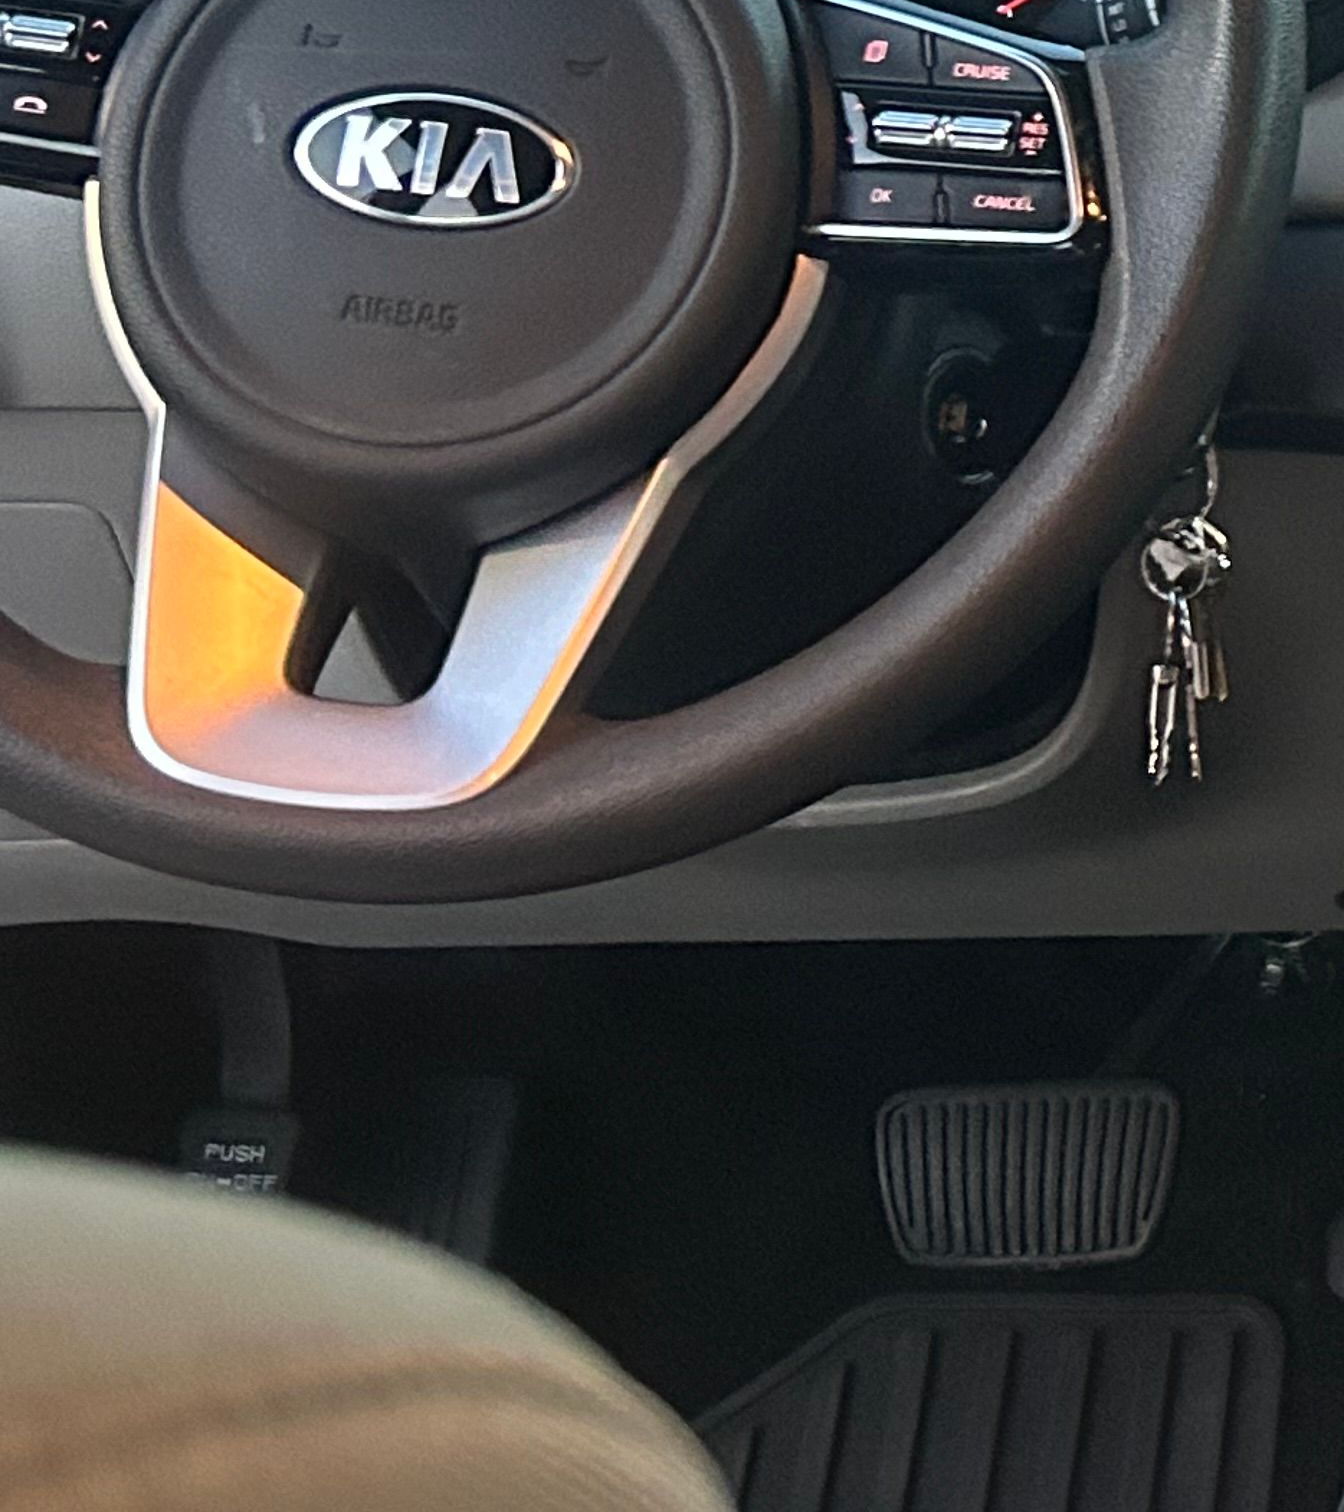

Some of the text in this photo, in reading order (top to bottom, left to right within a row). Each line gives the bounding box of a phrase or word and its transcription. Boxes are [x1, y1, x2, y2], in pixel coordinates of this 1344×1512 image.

[952, 62, 1012, 81] CRUISE
[336, 114, 520, 205] KIA
[870, 187, 893, 203] OK
[973, 193, 1036, 211] CANCEL
[339, 294, 460, 332] AIRBAG
[203, 1142, 267, 1164] PUSH
